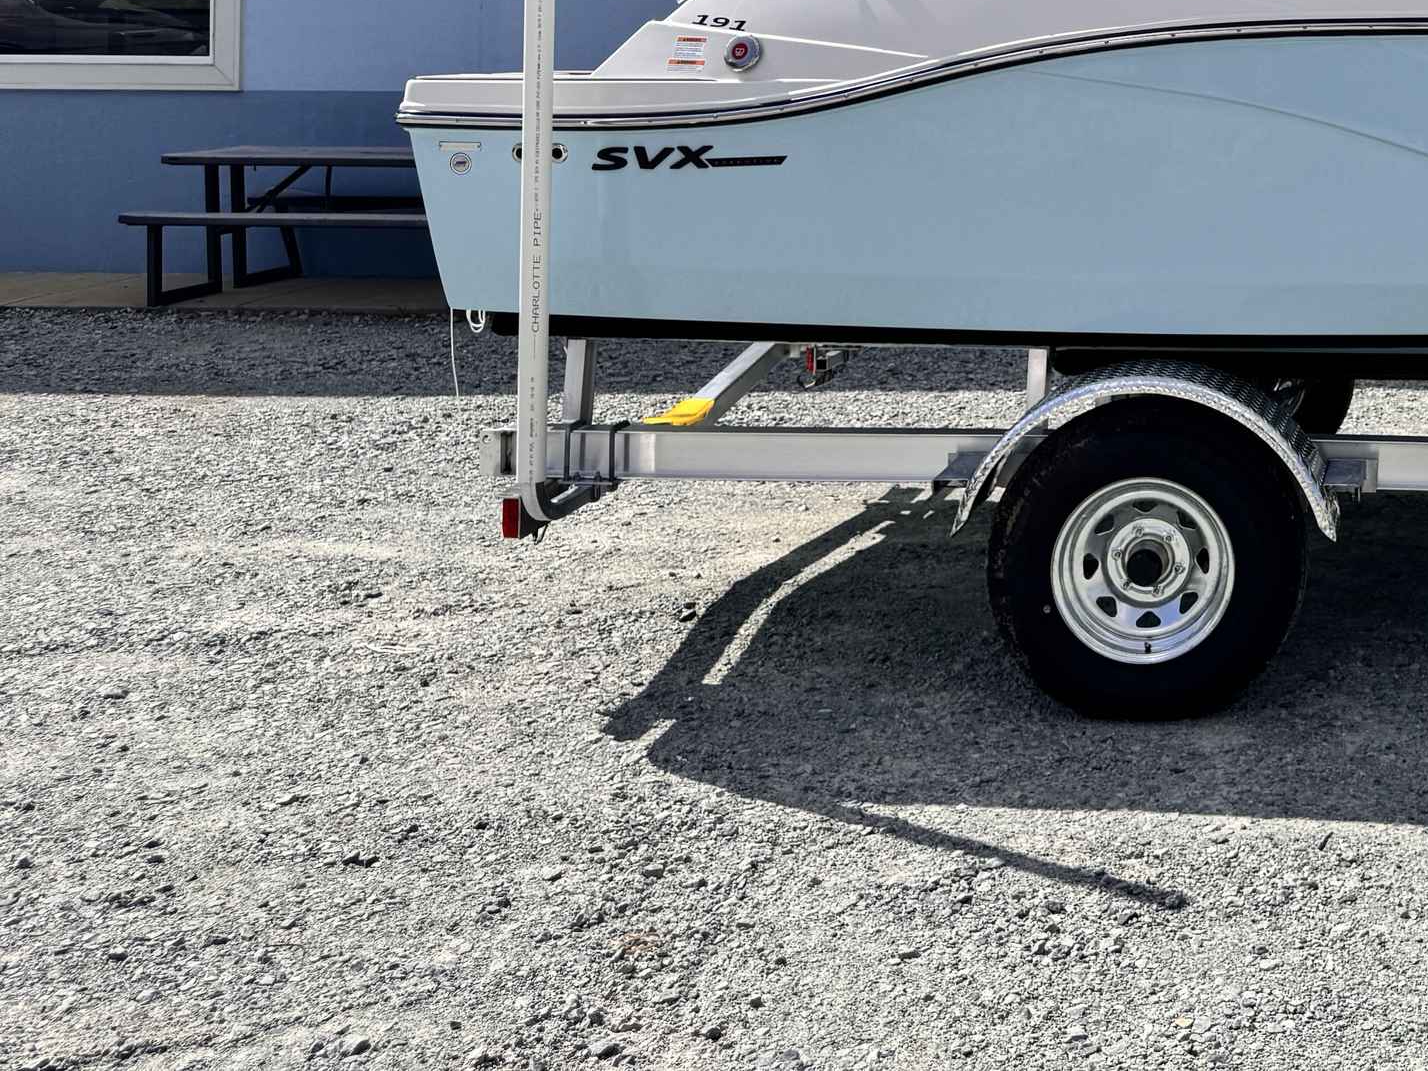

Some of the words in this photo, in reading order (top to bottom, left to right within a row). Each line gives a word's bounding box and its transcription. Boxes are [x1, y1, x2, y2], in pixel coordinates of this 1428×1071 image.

[692, 14, 746, 31] 191
[591, 145, 714, 171] SVX
[533, 211, 542, 247] PIPE
[531, 255, 542, 333] CHARLOTTE
